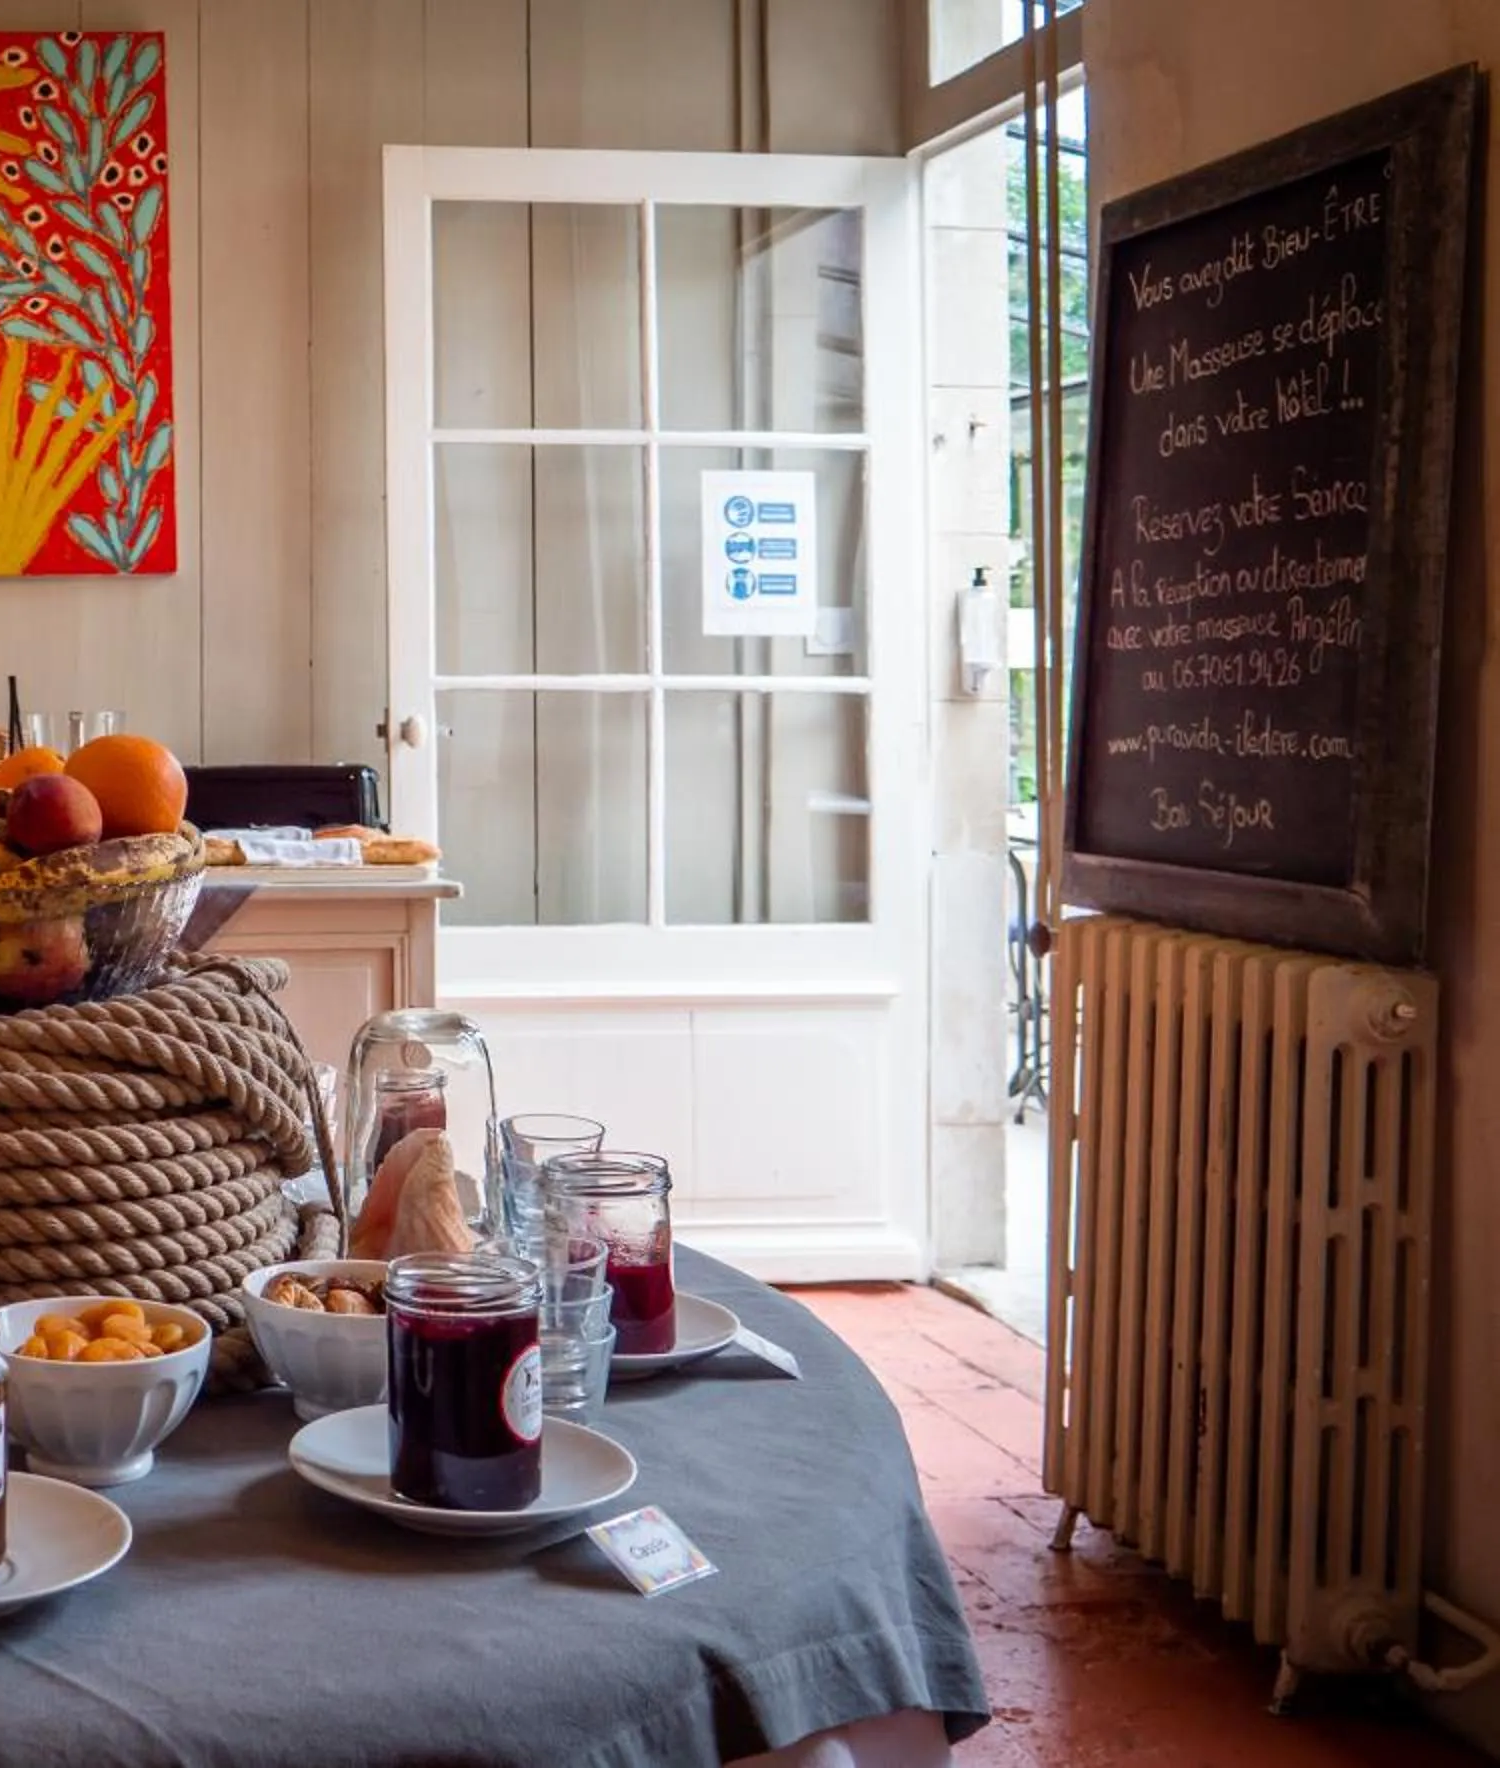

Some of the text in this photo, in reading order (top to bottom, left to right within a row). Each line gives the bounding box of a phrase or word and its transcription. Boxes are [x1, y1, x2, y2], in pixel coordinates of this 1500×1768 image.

[1129, 260, 1173, 311] Vous
[1179, 262, 1224, 308] avez
[1222, 232, 1255, 279] dit
[1169, 330, 1266, 386] Masseuse
[1272, 321, 1295, 352] se
[1159, 411, 1208, 458] dans
[1214, 389, 1270, 436] votre
[1149, 612, 1192, 648] votre
